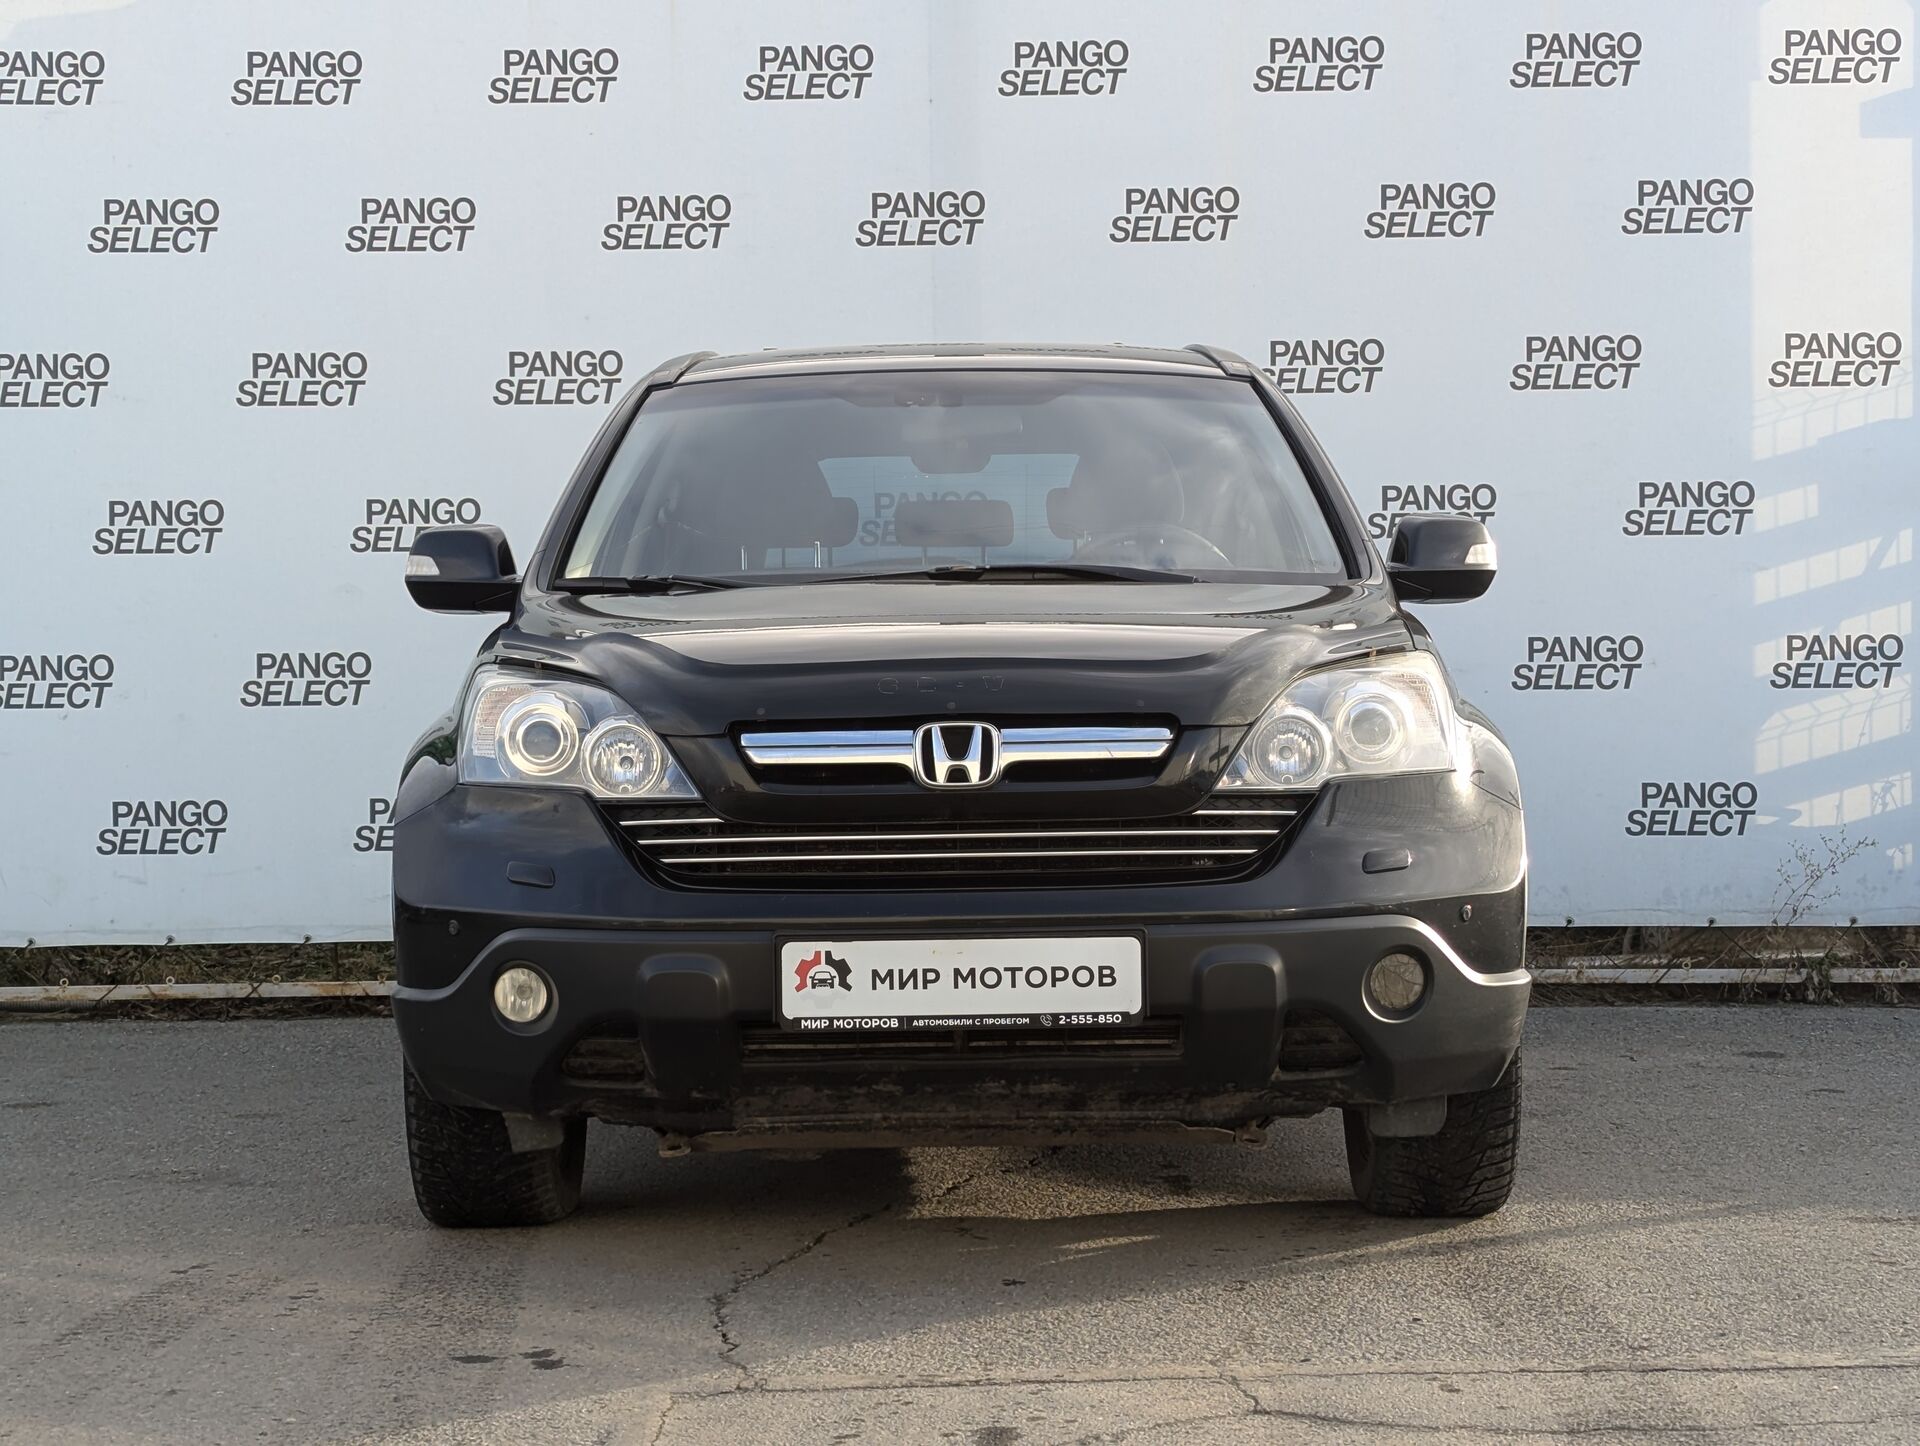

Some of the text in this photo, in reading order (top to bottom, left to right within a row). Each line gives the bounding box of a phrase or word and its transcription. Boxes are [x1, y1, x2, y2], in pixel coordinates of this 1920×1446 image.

[1015, 40, 1128, 67] PANGO
[1270, 36, 1384, 63] PANGO
[1527, 32, 1641, 59] PANGO
[1786, 29, 1901, 55] PANGO
[248, 51, 362, 77] PANGO
[505, 49, 618, 75] PANGO
[760, 45, 873, 72] PANGO
[1769, 57, 1899, 84] SELECT
[744, 73, 872, 100] SELECT
[999, 69, 1127, 96] SELECT
[1254, 64, 1382, 92] SELECT
[1510, 61, 1640, 88] SELECT
[0, 79, 104, 105] ELECT
[231, 79, 360, 105] SELECT
[488, 77, 617, 103] SELECT
[872, 191, 985, 218] PANGO
[1126, 187, 1239, 214] PANGO
[1381, 183, 1495, 209] PANGO
[1639, 179, 1753, 206] PANGO
[104, 199, 219, 225] PANGO
[362, 198, 475, 223] PANGO
[618, 195, 731, 221] PANGO
[1622, 207, 1752, 234] SELECT
[602, 223, 729, 250] SELECT
[856, 219, 984, 246] SELECT
[1110, 215, 1238, 242] SELECT
[1365, 211, 1494, 238] SELECT
[88, 227, 217, 253] SELECT
[346, 226, 474, 252] SELECT
[1271, 339, 1384, 366] PANGO
[1527, 335, 1641, 362] PANGO
[1786, 332, 1901, 358] PANGO
[253, 352, 367, 378] PANGO
[509, 350, 622, 377] PANGO
[1510, 363, 1640, 390] SELECT
[1769, 361, 1900, 387] SELECT
[0, 381, 109, 407] ELECT
[236, 380, 366, 406] SELECT
[493, 379, 621, 405] SELECT
[1382, 484, 1496, 511] PANGO
[1639, 481, 1755, 507] PANGO
[109, 500, 224, 526] PANGO
[367, 498, 480, 524] PANGO
[1623, 509, 1753, 536] SELECT
[93, 528, 222, 554] SELECT
[1528, 636, 1643, 662] PANGO
[1787, 635, 1903, 661] PANGO
[0, 655, 114, 681] PANGO
[257, 652, 371, 678] PANGO
[1512, 663, 1642, 690] SELECT
[1770, 662, 1902, 689] SELECT
[0, 682, 113, 709] ELECT
[240, 680, 370, 707] SELECT
[1642, 782, 1757, 808] PANGO
[113, 800, 227, 827] PANGO
[1625, 810, 1756, 836] SELECT
[96, 828, 226, 855] SELECT
[871, 965, 1117, 991] МИР МОТОРОВ
[801, 1014, 1122, 1029] МИР МОТОРОВ АВТОМОБИЛИ С ПРОБЕГОМ 2-555-850
